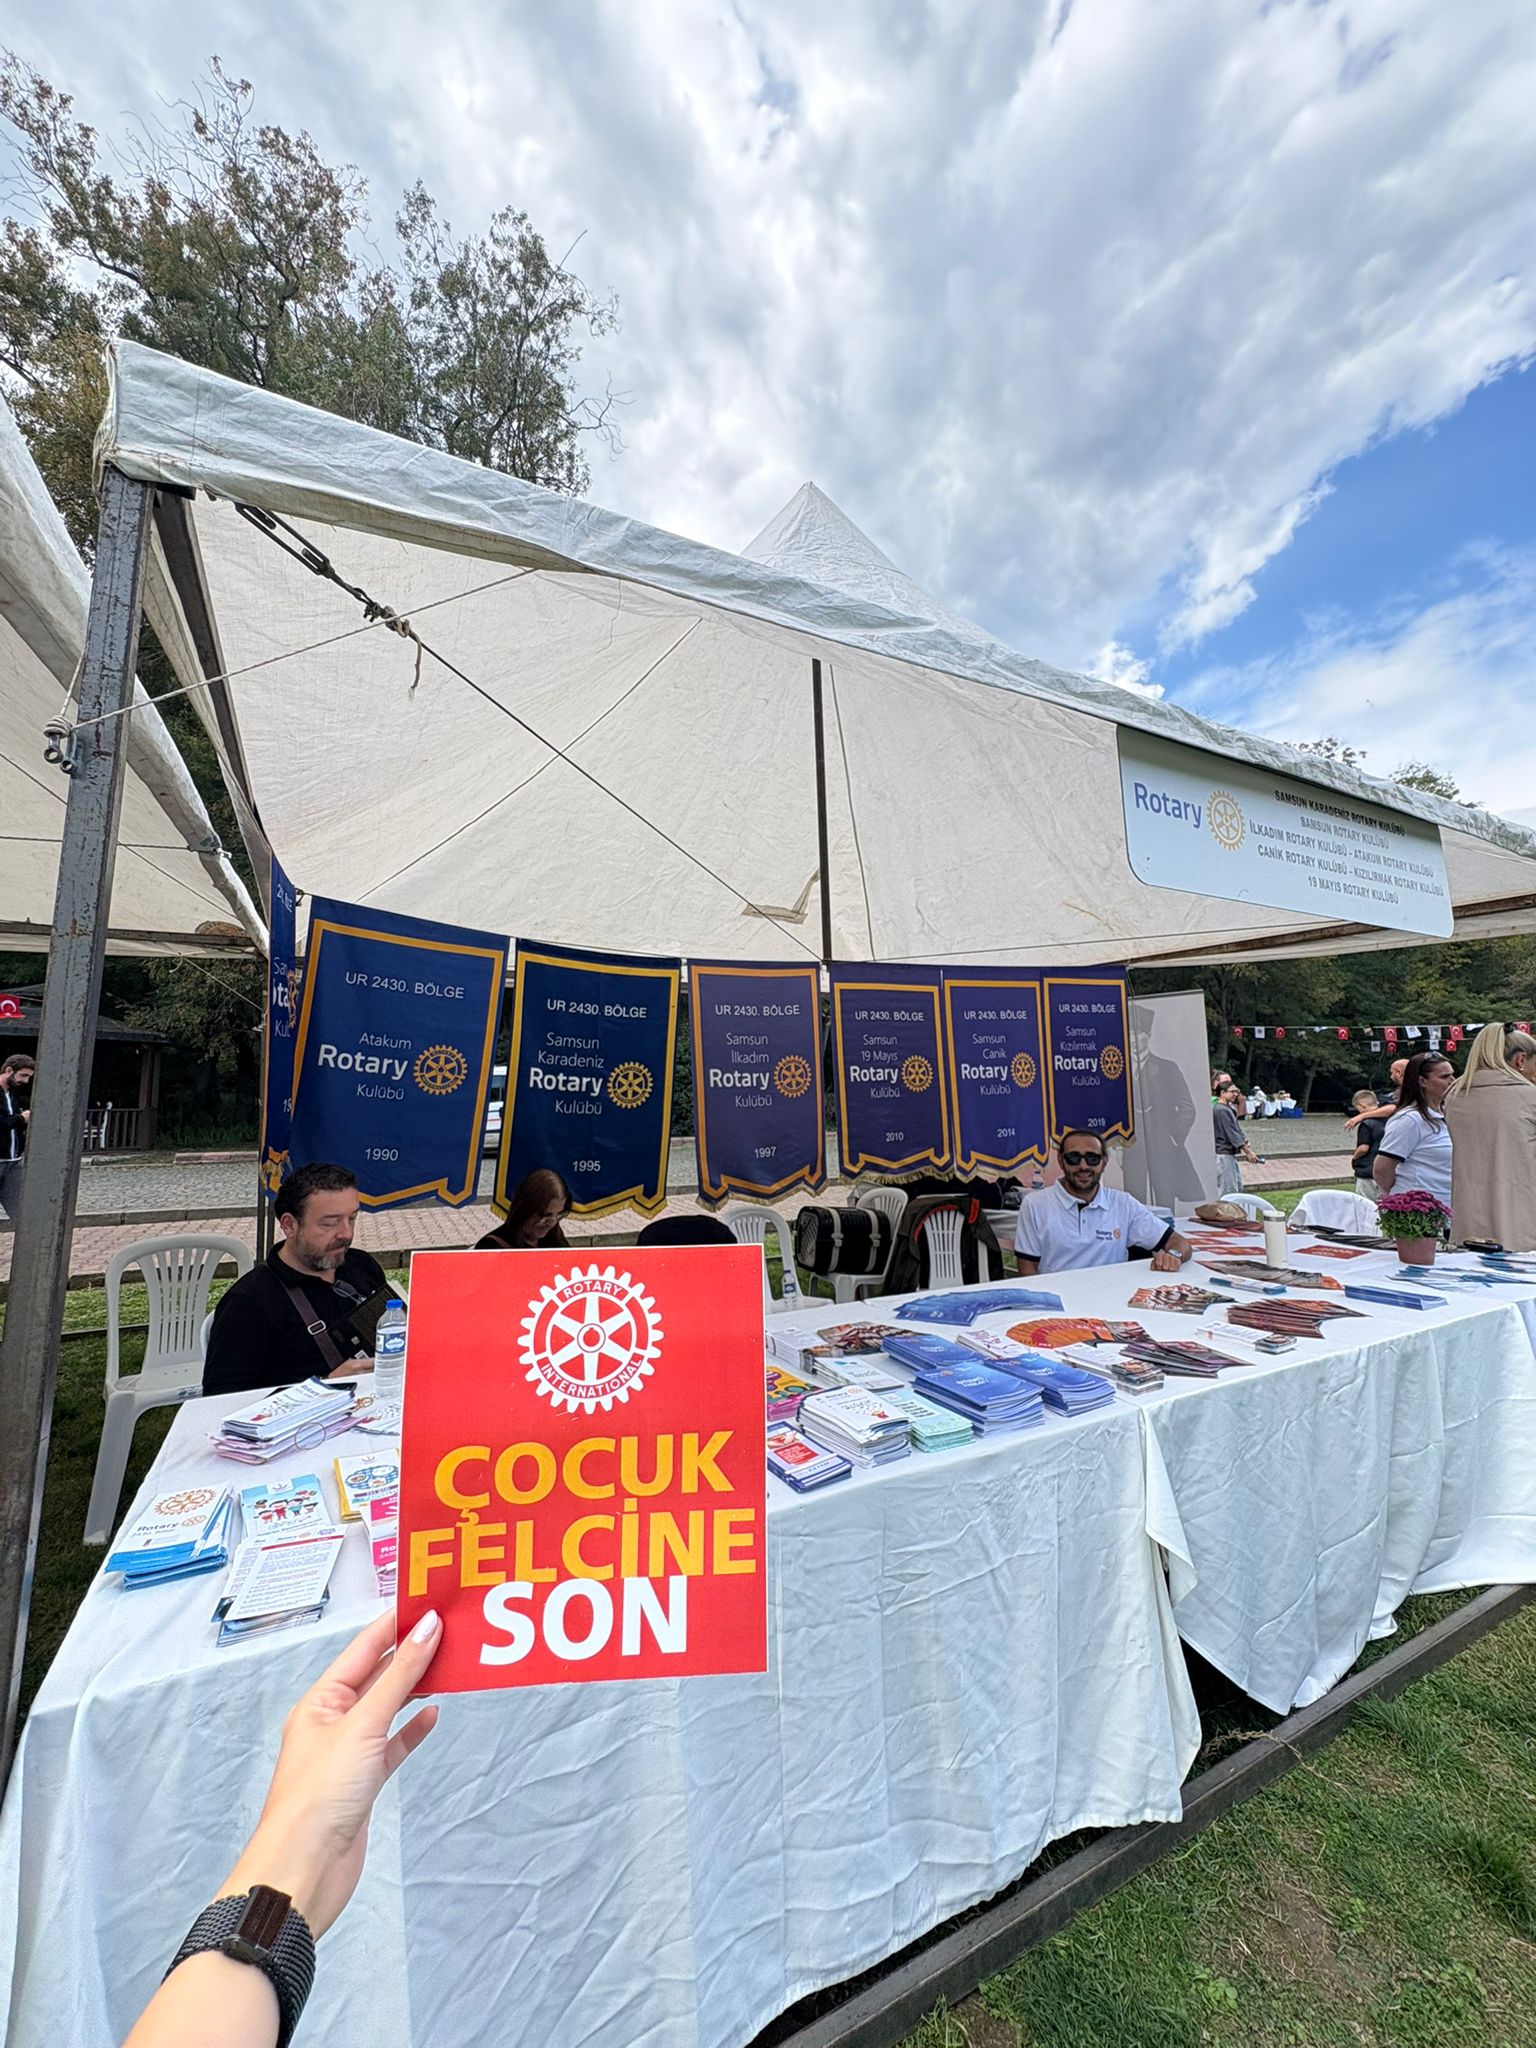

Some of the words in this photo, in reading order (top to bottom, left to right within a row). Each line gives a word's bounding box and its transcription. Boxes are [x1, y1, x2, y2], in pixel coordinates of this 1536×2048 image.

[1134, 782, 1202, 829] Rotary
[1274, 790, 1307, 809] SAMSUN
[1309, 799, 1350, 820] KARADENİZ
[1351, 812, 1377, 828] ROTARY
[1378, 819, 1405, 836] KULÜBÜ
[1300, 816, 1332, 835] SAMSUN
[1333, 825, 1360, 841] ROTARY
[1362, 831, 1389, 849] KULÜBÜ
[1250, 820, 1284, 840] İLKADIM
[1286, 831, 1316, 849] ROTARY
[1318, 840, 1347, 856] KULÜBÜ
[1354, 849, 1382, 865] ATAKUM
[1382, 855, 1408, 871] ROTARY
[1409, 861, 1434, 878] KULÜBÜ
[1258, 844, 1284, 861] CANİK
[1286, 851, 1316, 868] ROTARY
[1318, 859, 1348, 875] KULÜBÜ
[1354, 867, 1393, 886] KIZILIRMAK
[1394, 877, 1418, 892] ROTARY
[1420, 881, 1444, 896] KULÜBÜ
[1308, 876, 1318, 888] 19
[1319, 878, 1342, 893] MAYIS
[1343, 883, 1370, 898] ROTARY
[1372, 888, 1399, 904] KULÜBÜ
[345, 972, 368, 986] UR
[372, 976, 410, 992] 2430.
[414, 982, 465, 998] BÖLGE
[547, 998, 566, 1012] UR
[568, 1002, 601, 1016] 2430.
[604, 1004, 647, 1018] BÖLGE
[715, 1004, 732, 1016] UR
[734, 1006, 760, 1016] 2430.
[763, 1004, 800, 1016] BÖLGE
[964, 1010, 977, 1020] UR
[1000, 1010, 1027, 1020] BÖLGE
[1058, 1004, 1071, 1013] UR
[1092, 1003, 1116, 1014] BÖLGE
[855, 1011, 868, 1020] UR
[870, 1011, 892, 1020] 2430.
[894, 1010, 924, 1022] BÖLGE
[972, 1033, 1006, 1044] Samsun
[1065, 1026, 1096, 1036] Samsun
[359, 1032, 412, 1050] Atakum
[546, 1032, 600, 1049] Samsun
[726, 1032, 768, 1046] Samsun
[863, 1034, 898, 1046] Samsun
[1060, 1040, 1096, 1051] Kızılırmak
[538, 1050, 604, 1068] Karadeniz
[732, 1051, 770, 1064] İlkadım
[861, 1050, 870, 1062] 19
[873, 1050, 898, 1064] Mayıs
[982, 1048, 1006, 1060] Canik
[317, 1044, 408, 1080] Rotary
[1054, 1055, 1098, 1072] Rotary
[710, 1068, 770, 1090] Rotary
[850, 1066, 898, 1084] Rotary
[960, 1063, 1008, 1081] Rotary
[529, 1067, 604, 1097] Rotary
[1072, 1076, 1100, 1086] Kulübü
[356, 1083, 404, 1100] Kulübü
[870, 1087, 900, 1098] Kulübü
[980, 1084, 1011, 1096] Kulübü
[555, 1100, 602, 1114] Kulübü
[735, 1094, 772, 1107] Kulübü
[886, 1132, 904, 1142] 2010
[997, 1128, 1016, 1138] 2014
[364, 1148, 399, 1161] 1990
[754, 1146, 776, 1159] 1997
[572, 1160, 600, 1172] 1995
[563, 1280, 623, 1299] ROTARY
[541, 1358, 642, 1398] INTERNATIONAL
[434, 1430, 735, 1527] ÇOCUK
[137, 1522, 180, 1532] Rotary
[408, 1497, 757, 1598] FELCİNE
[479, 1574, 688, 1666] SON
